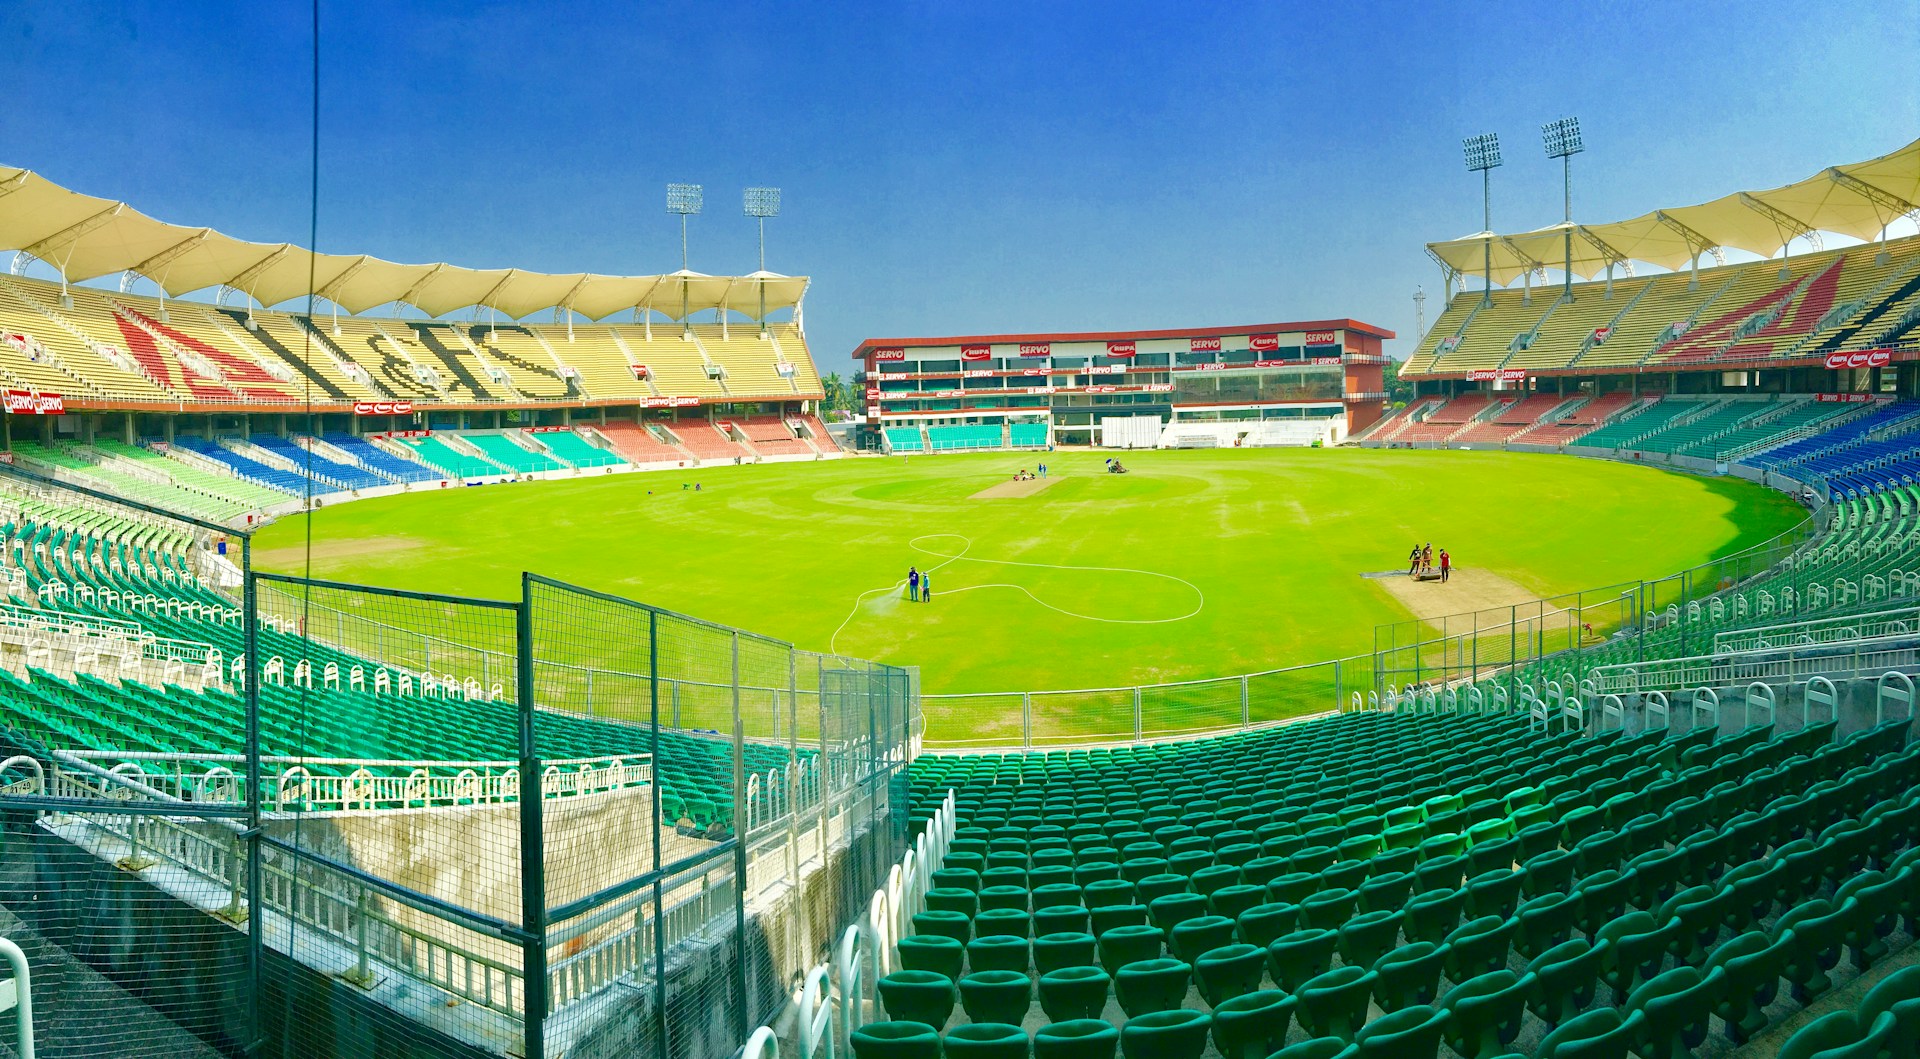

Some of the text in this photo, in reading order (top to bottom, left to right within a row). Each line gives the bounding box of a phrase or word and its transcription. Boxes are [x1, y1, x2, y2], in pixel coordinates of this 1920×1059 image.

[1306, 333, 1334, 342] SERVO
[1191, 340, 1220, 348] SERVO
[1020, 345, 1049, 354] SERVO
[876, 350, 903, 359] SERVO
[1474, 371, 1525, 379] SERVO SERVO
[11, 394, 63, 410] SERVO SERVO
